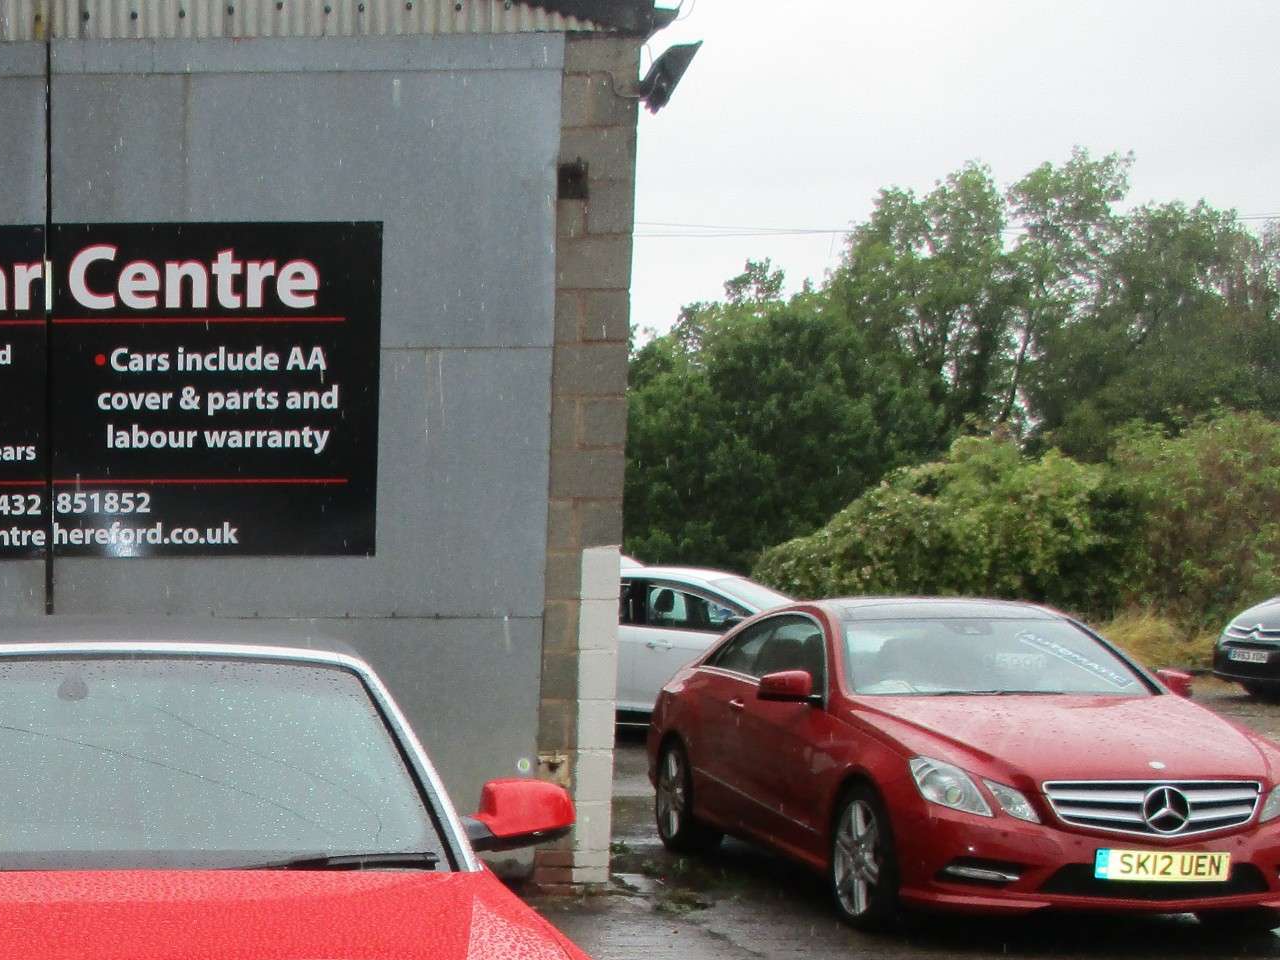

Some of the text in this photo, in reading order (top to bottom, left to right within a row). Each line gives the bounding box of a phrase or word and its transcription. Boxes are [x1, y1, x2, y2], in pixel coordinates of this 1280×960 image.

[69, 244, 319, 310] Centre
[111, 346, 327, 372] Cars include AA
[97, 385, 339, 415] cover & parts and
[107, 424, 330, 453] labour warranty
[56, 492, 151, 514] 851852
[1120, 853, 1222, 877] SK12 UEN
